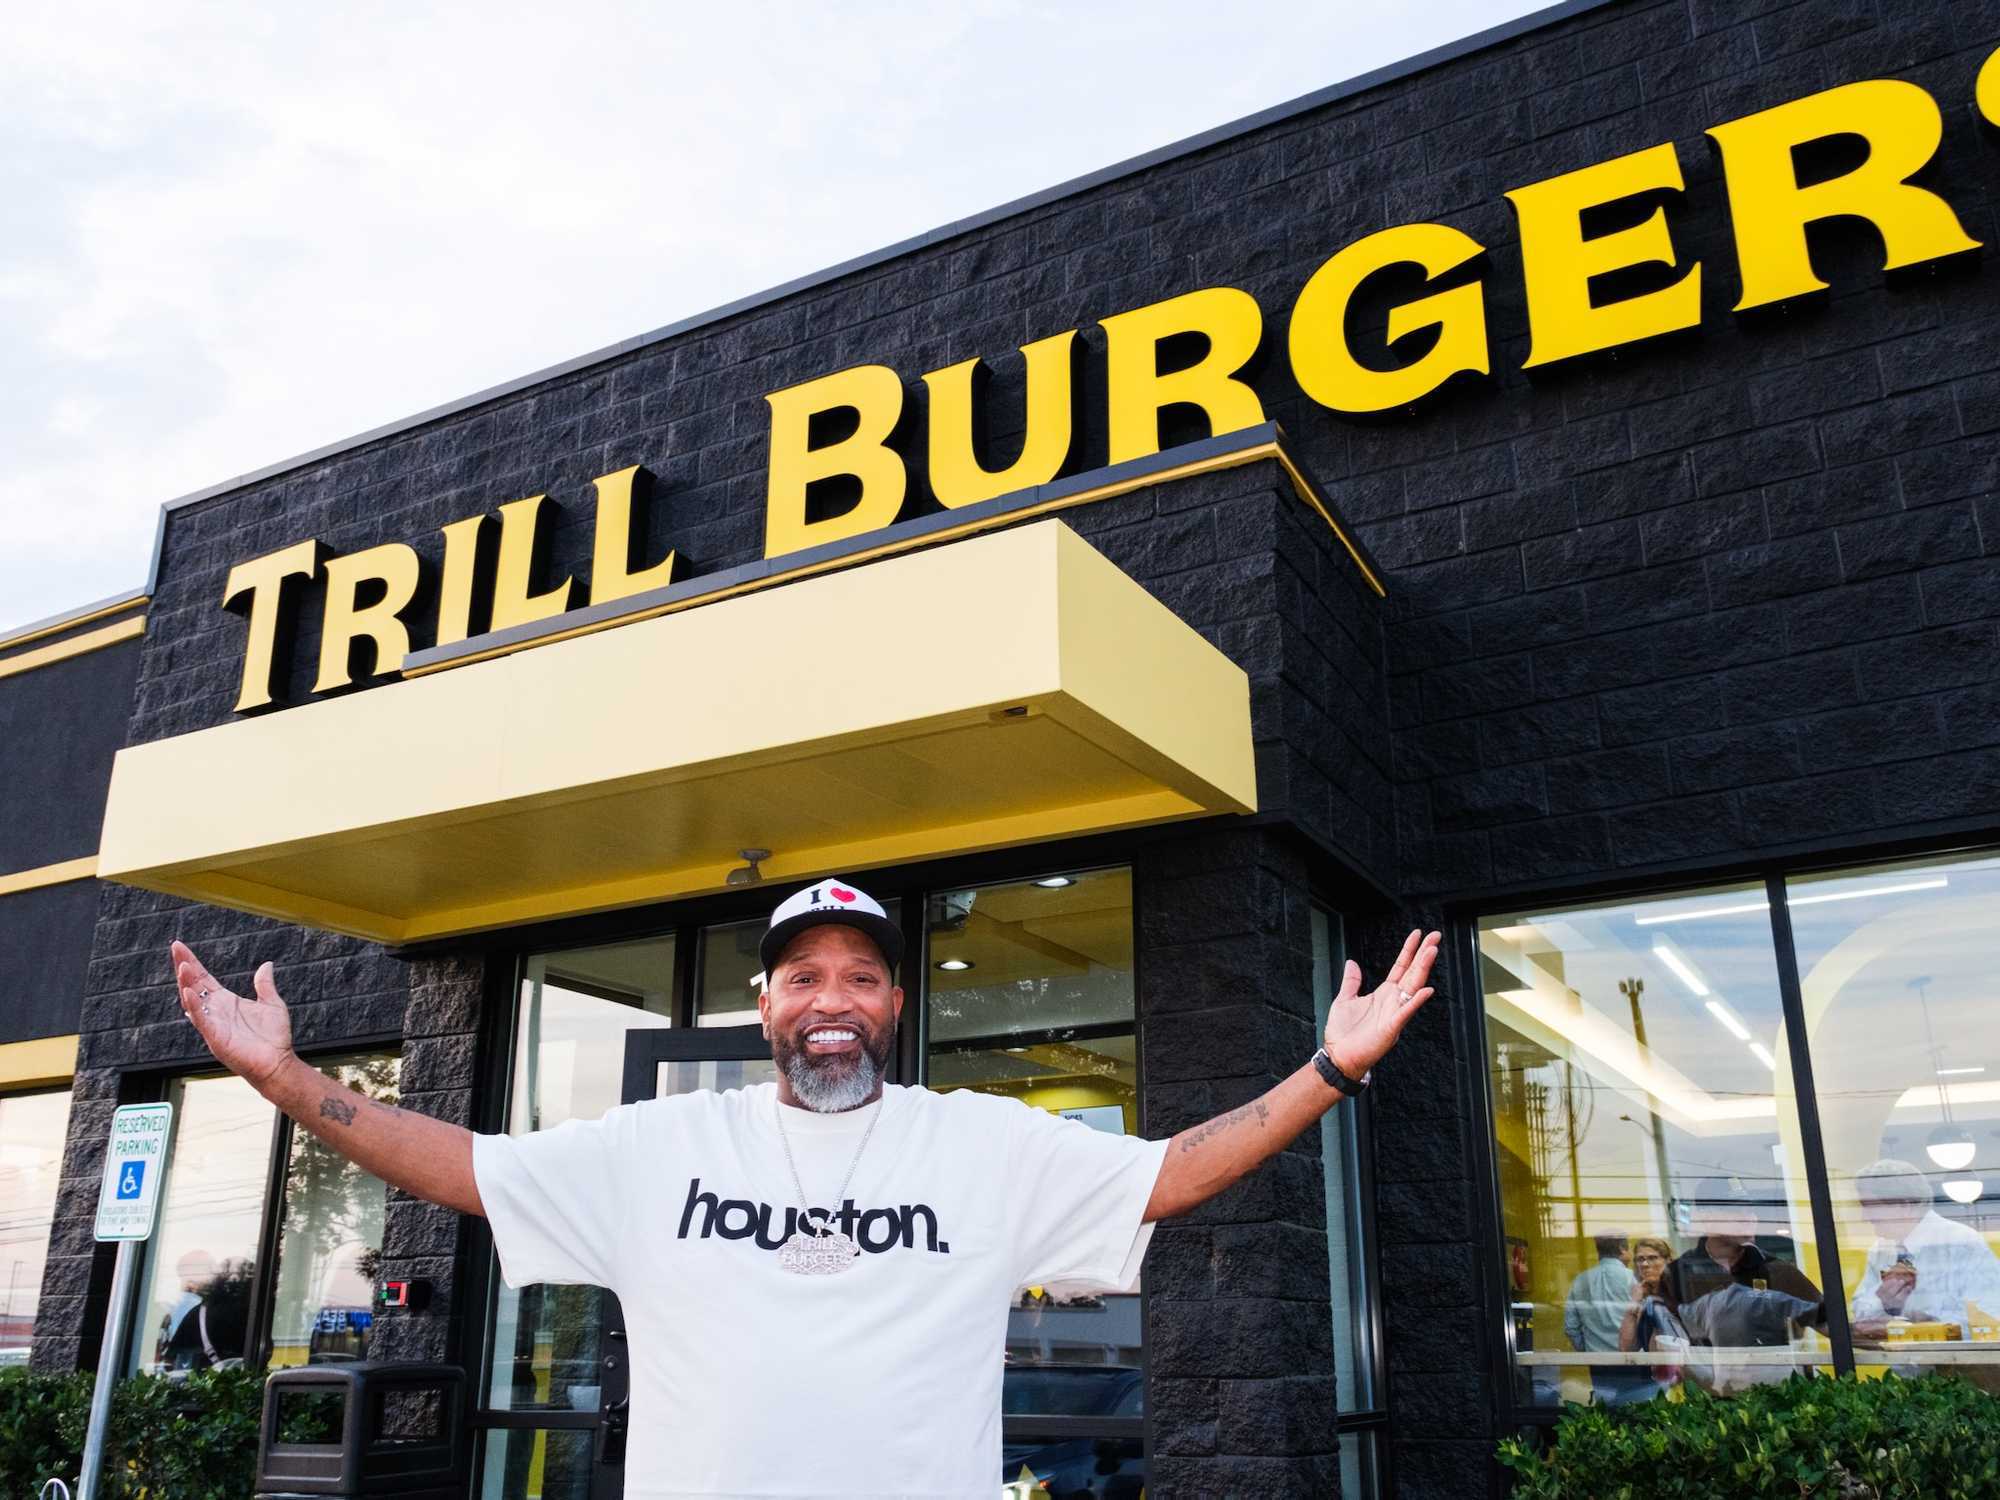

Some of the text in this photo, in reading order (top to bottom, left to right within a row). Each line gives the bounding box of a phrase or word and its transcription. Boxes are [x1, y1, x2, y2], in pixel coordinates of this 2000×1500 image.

[222, 46, 2000, 713] TRILL BURGER
[810, 889, 821, 904] I
[117, 1115, 165, 1134] RESERVED
[116, 1138, 160, 1156] PARKING
